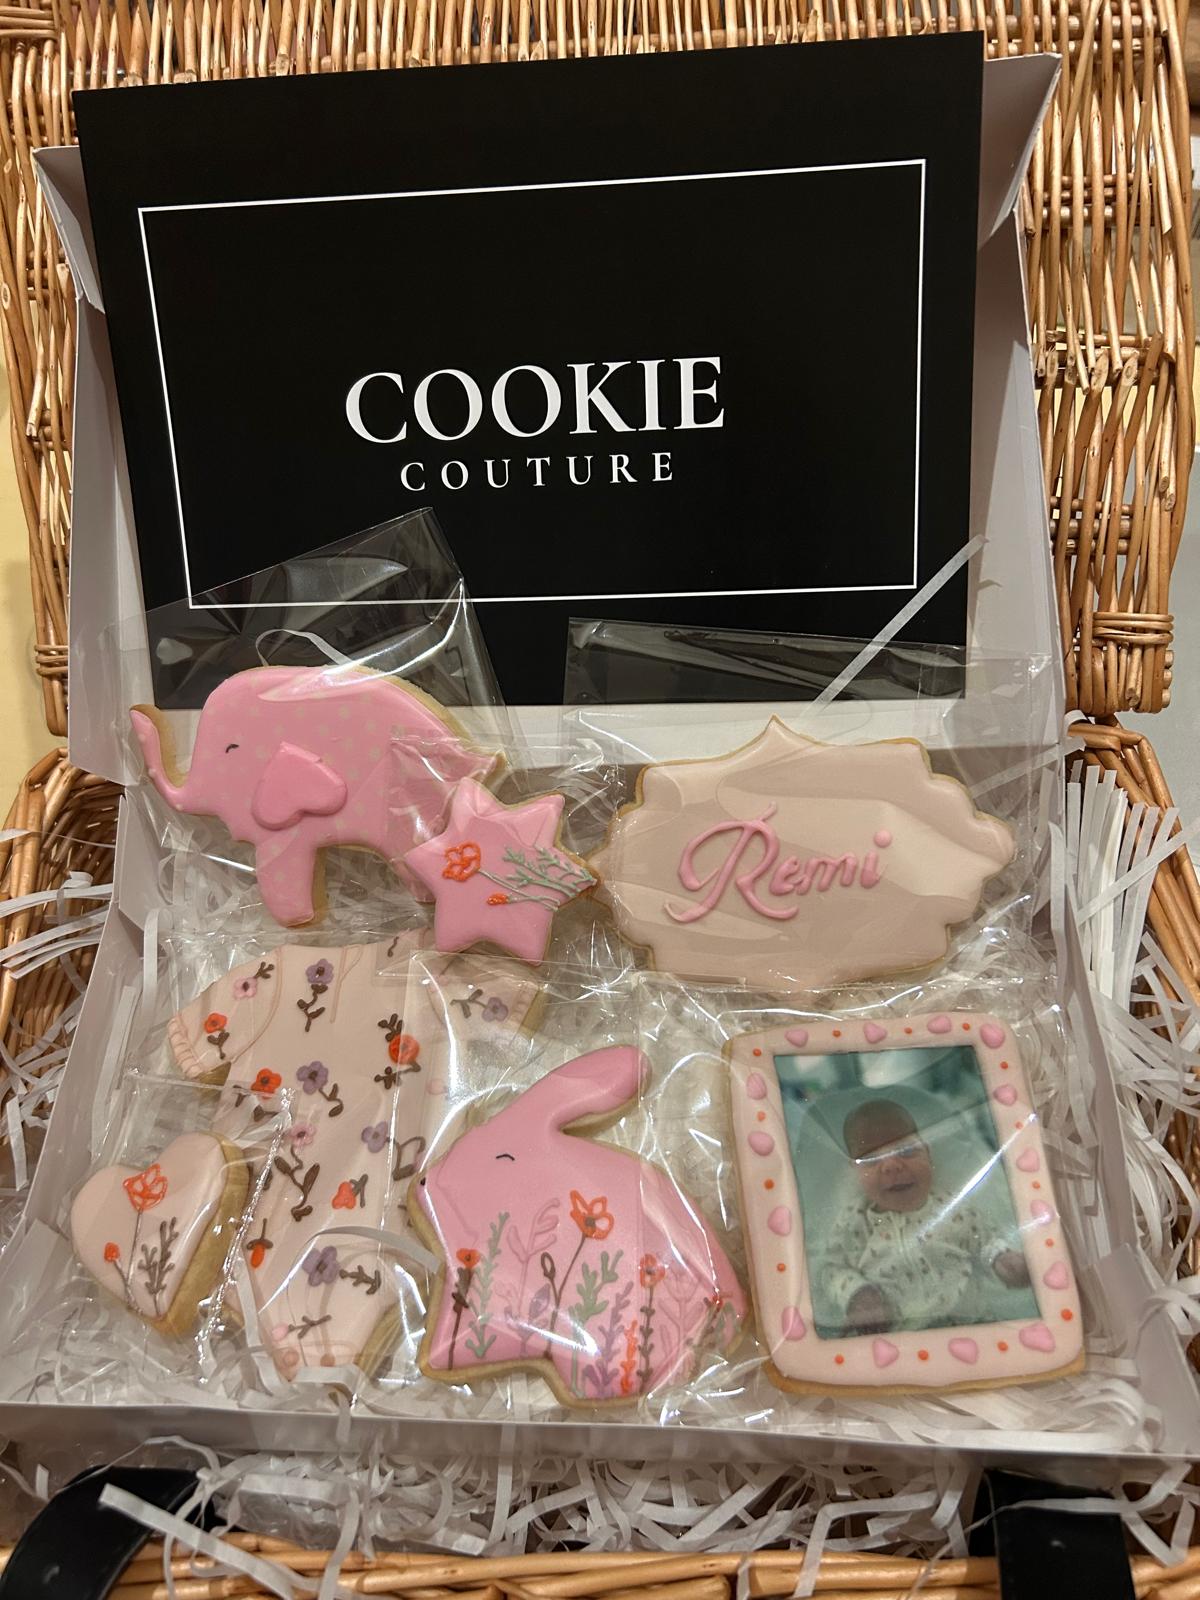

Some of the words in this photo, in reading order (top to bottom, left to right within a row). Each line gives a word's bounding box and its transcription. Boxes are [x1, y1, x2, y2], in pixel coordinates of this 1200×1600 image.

[345, 356, 725, 444] COOKIE
[399, 451, 674, 492] COUTURE
[664, 801, 892, 922] Remi
